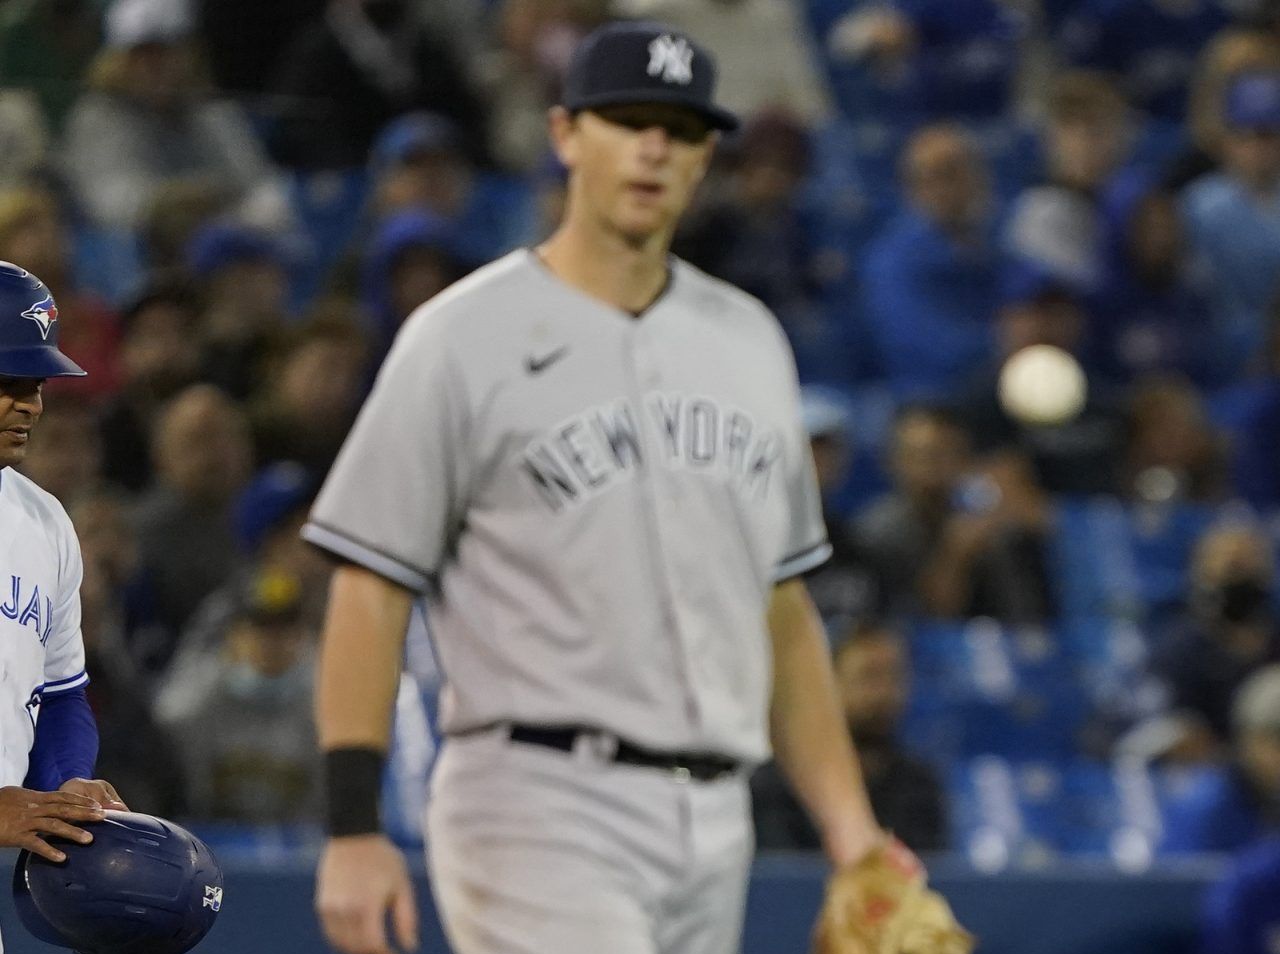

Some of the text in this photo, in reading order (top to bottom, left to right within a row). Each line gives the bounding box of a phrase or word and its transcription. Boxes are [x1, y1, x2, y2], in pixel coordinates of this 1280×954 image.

[646, 34, 694, 85] NY
[519, 393, 783, 513] NEW YORK
